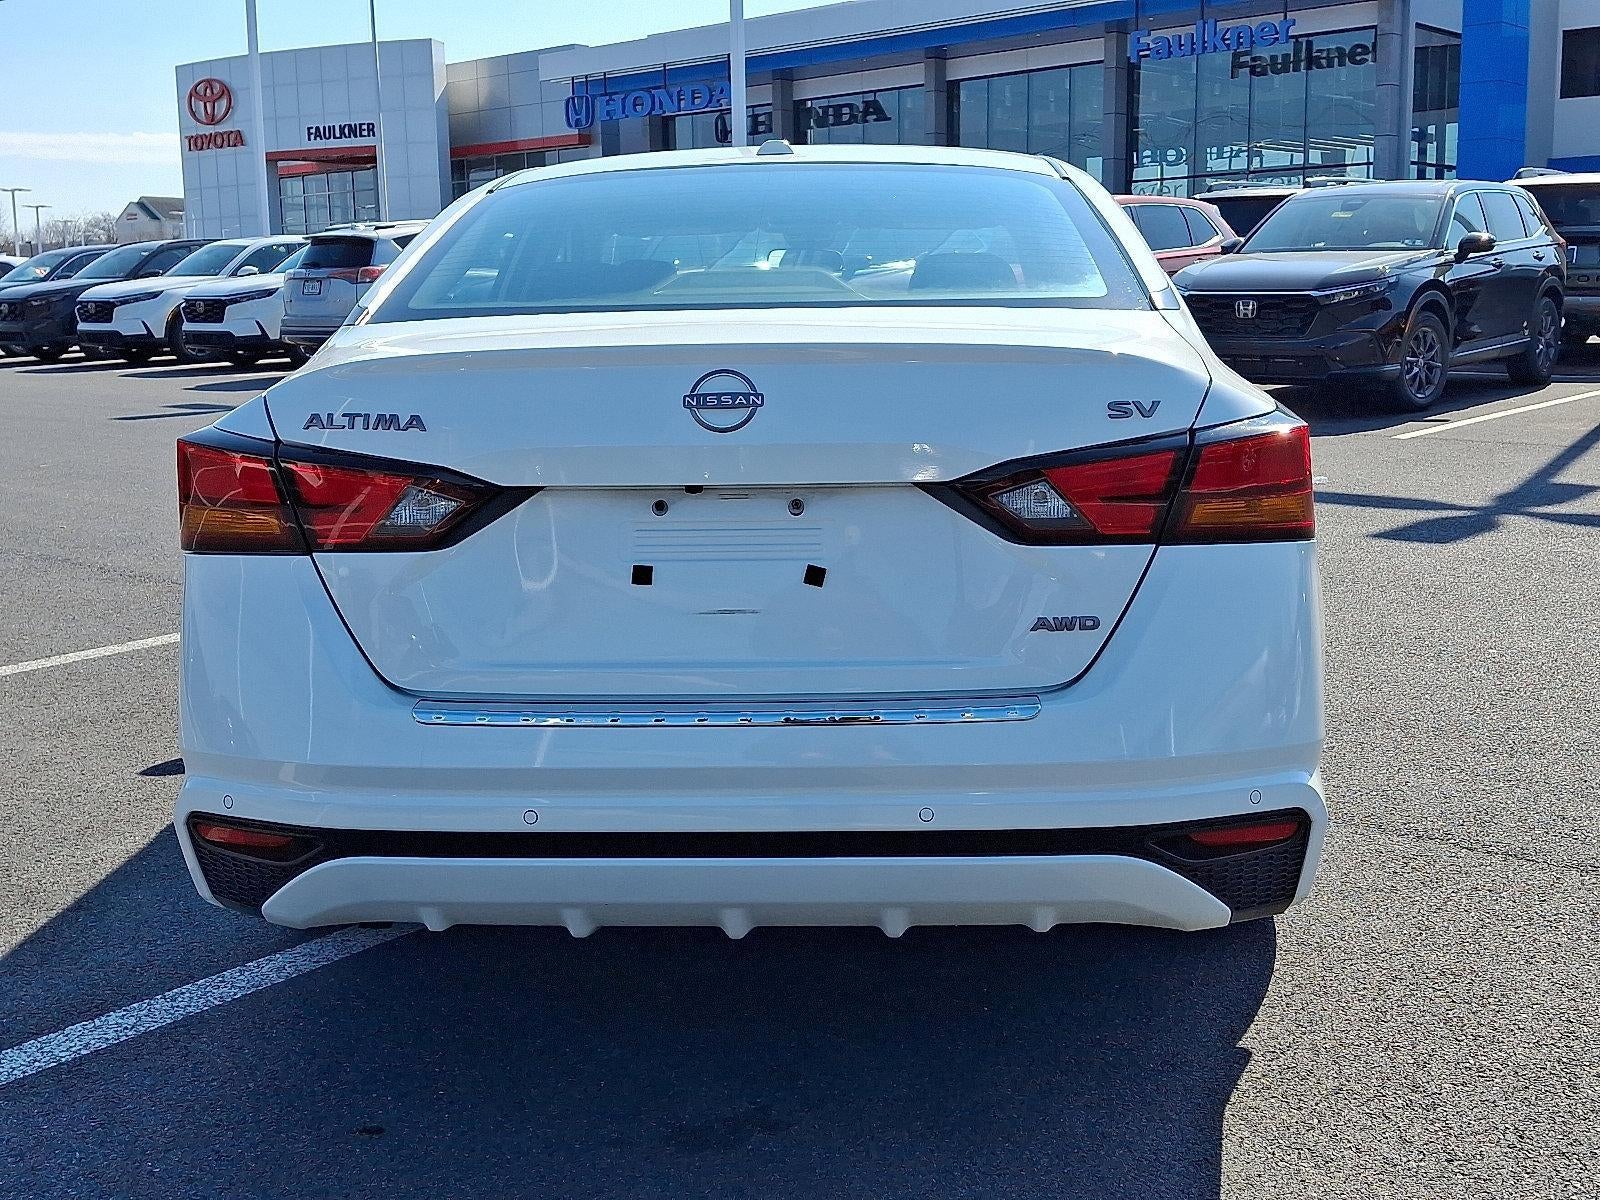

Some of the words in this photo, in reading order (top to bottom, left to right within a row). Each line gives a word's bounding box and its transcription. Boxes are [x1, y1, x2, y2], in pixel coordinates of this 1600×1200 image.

[1129, 18, 1297, 63] Faulkner
[184, 129, 246, 152] TOYOTA
[306, 122, 376, 142] FAULKNER
[684, 394, 763, 407] NISSAN
[1106, 400, 1162, 419] SV
[301, 412, 428, 432] ALTIMA
[1029, 615, 1101, 632] AWD
